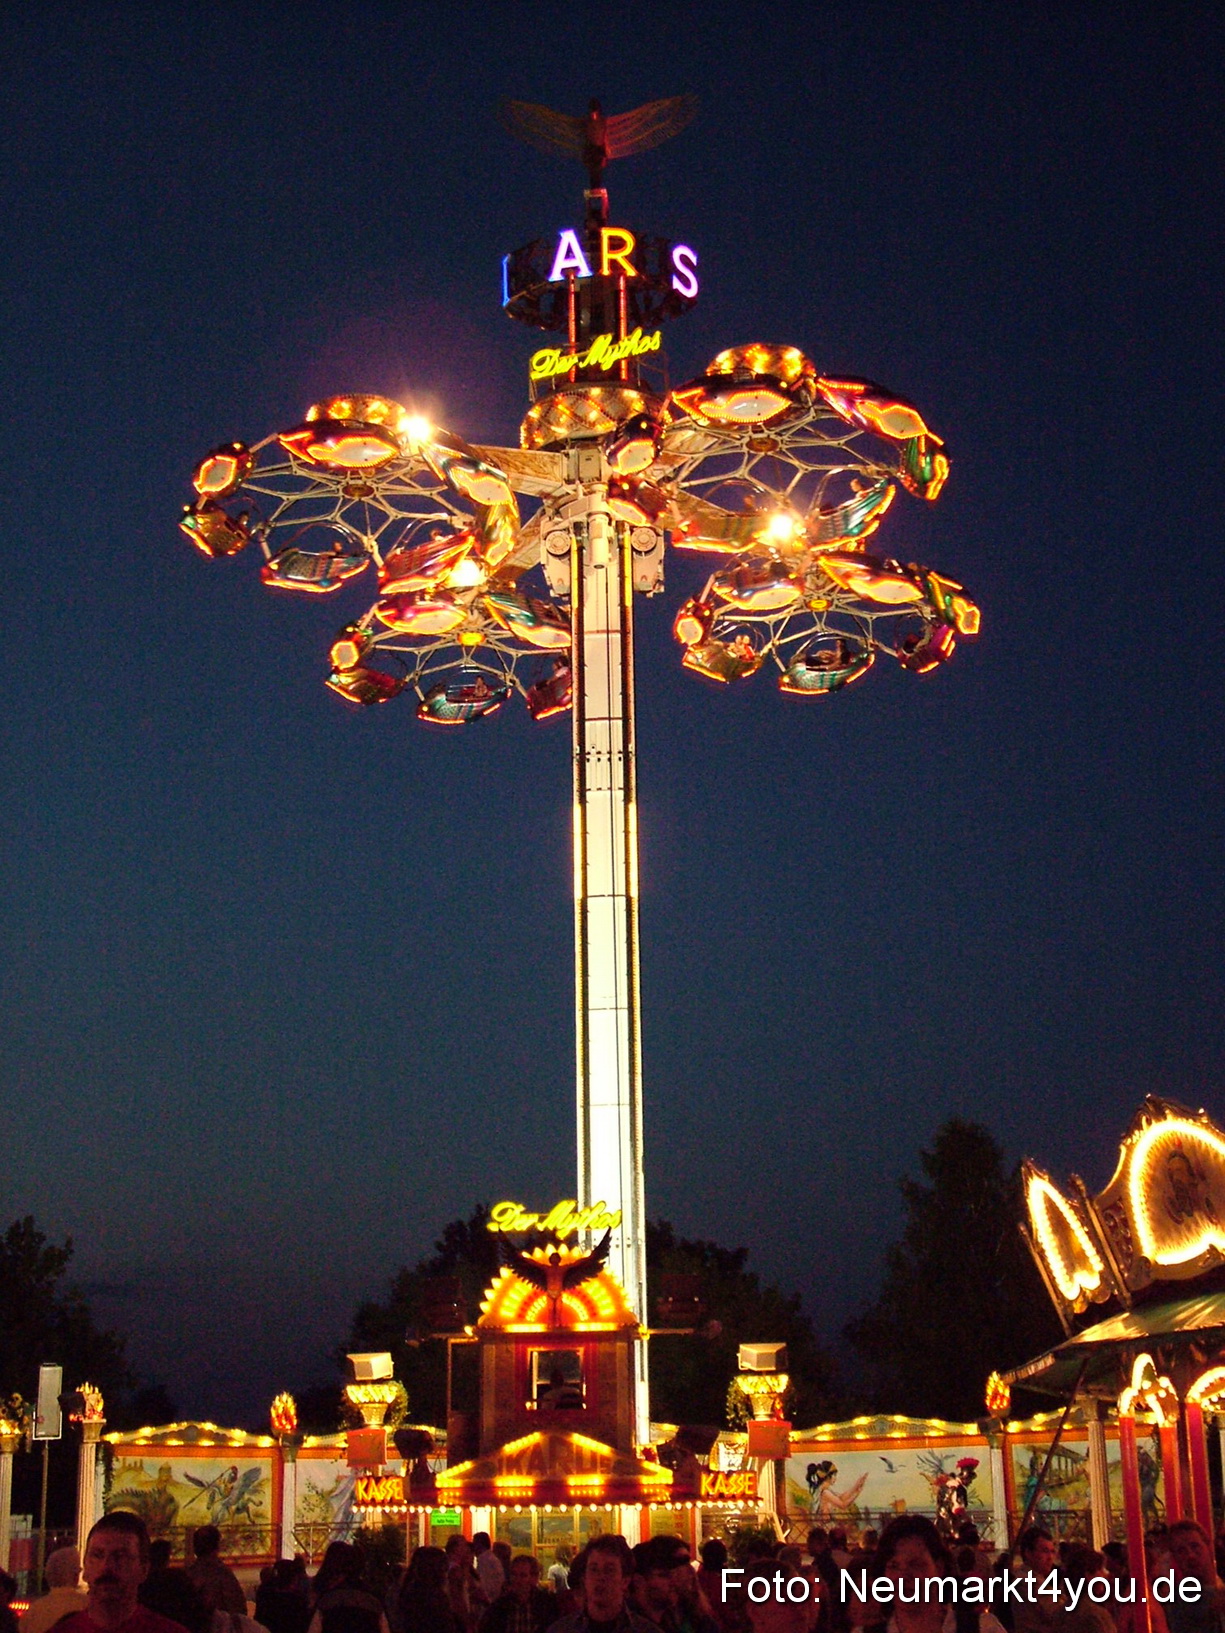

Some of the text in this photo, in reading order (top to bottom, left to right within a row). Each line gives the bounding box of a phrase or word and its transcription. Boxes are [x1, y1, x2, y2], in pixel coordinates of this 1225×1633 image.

[529, 326, 662, 380] Der Mythos
[487, 1200, 622, 1240] Der Mythos
[357, 1477, 403, 1502] KASSE
[701, 1472, 755, 1496] KASSE
